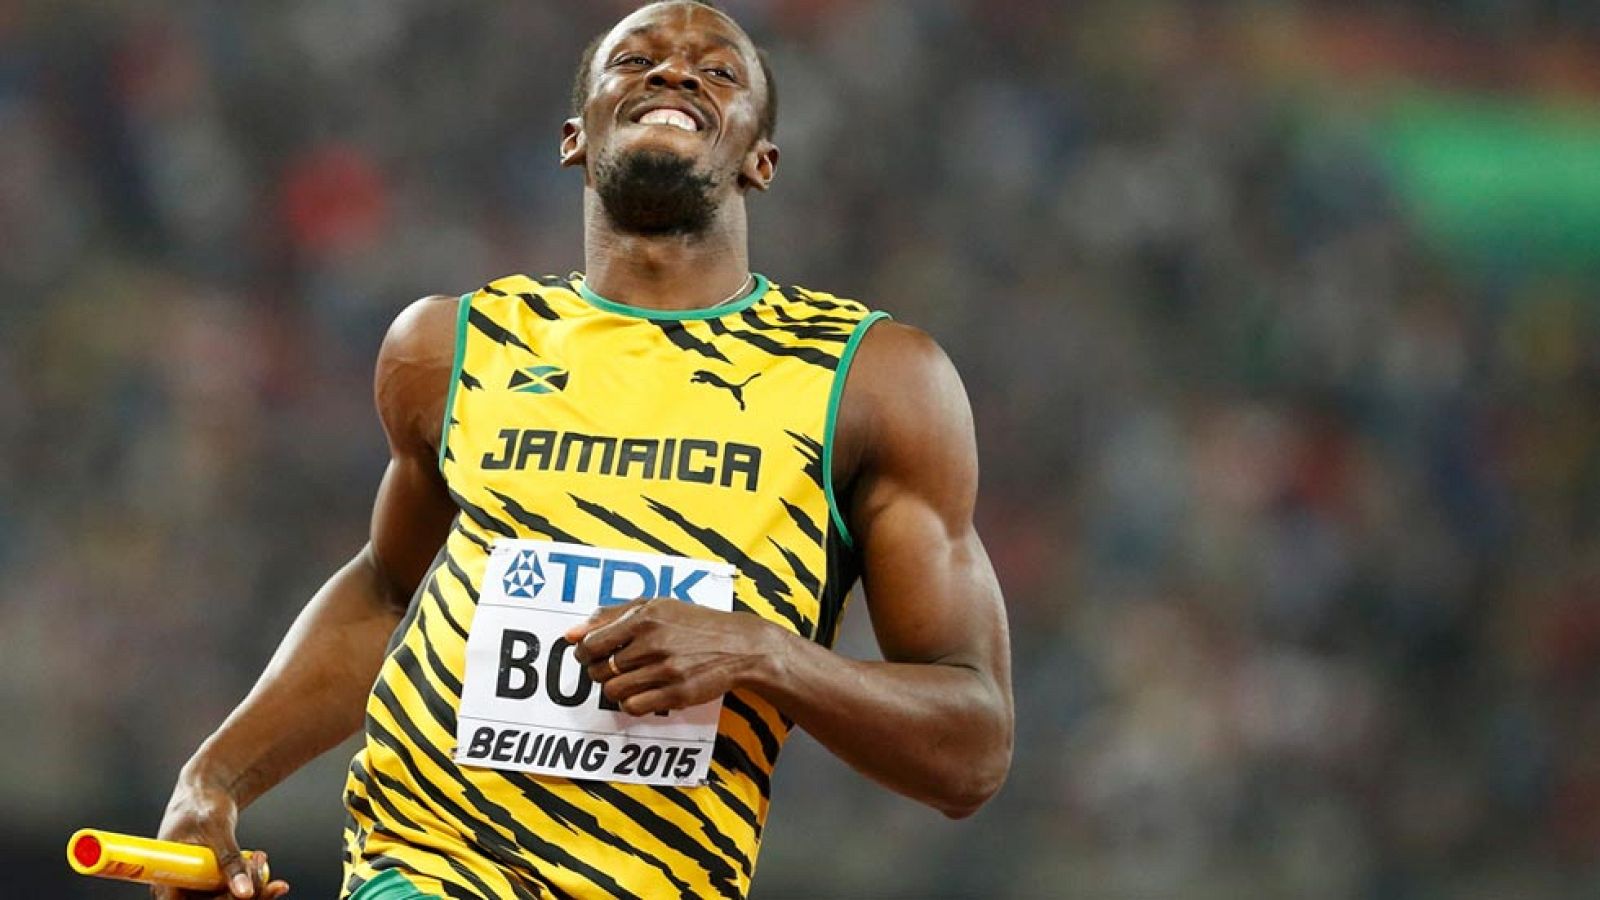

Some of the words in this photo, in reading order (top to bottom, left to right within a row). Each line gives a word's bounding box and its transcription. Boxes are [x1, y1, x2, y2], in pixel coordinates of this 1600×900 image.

[480, 429, 762, 492] JAMAICA
[548, 553, 710, 607] TDK
[495, 628, 670, 716] BO
[466, 726, 610, 772] BEIJING
[613, 744, 702, 778] 2015
